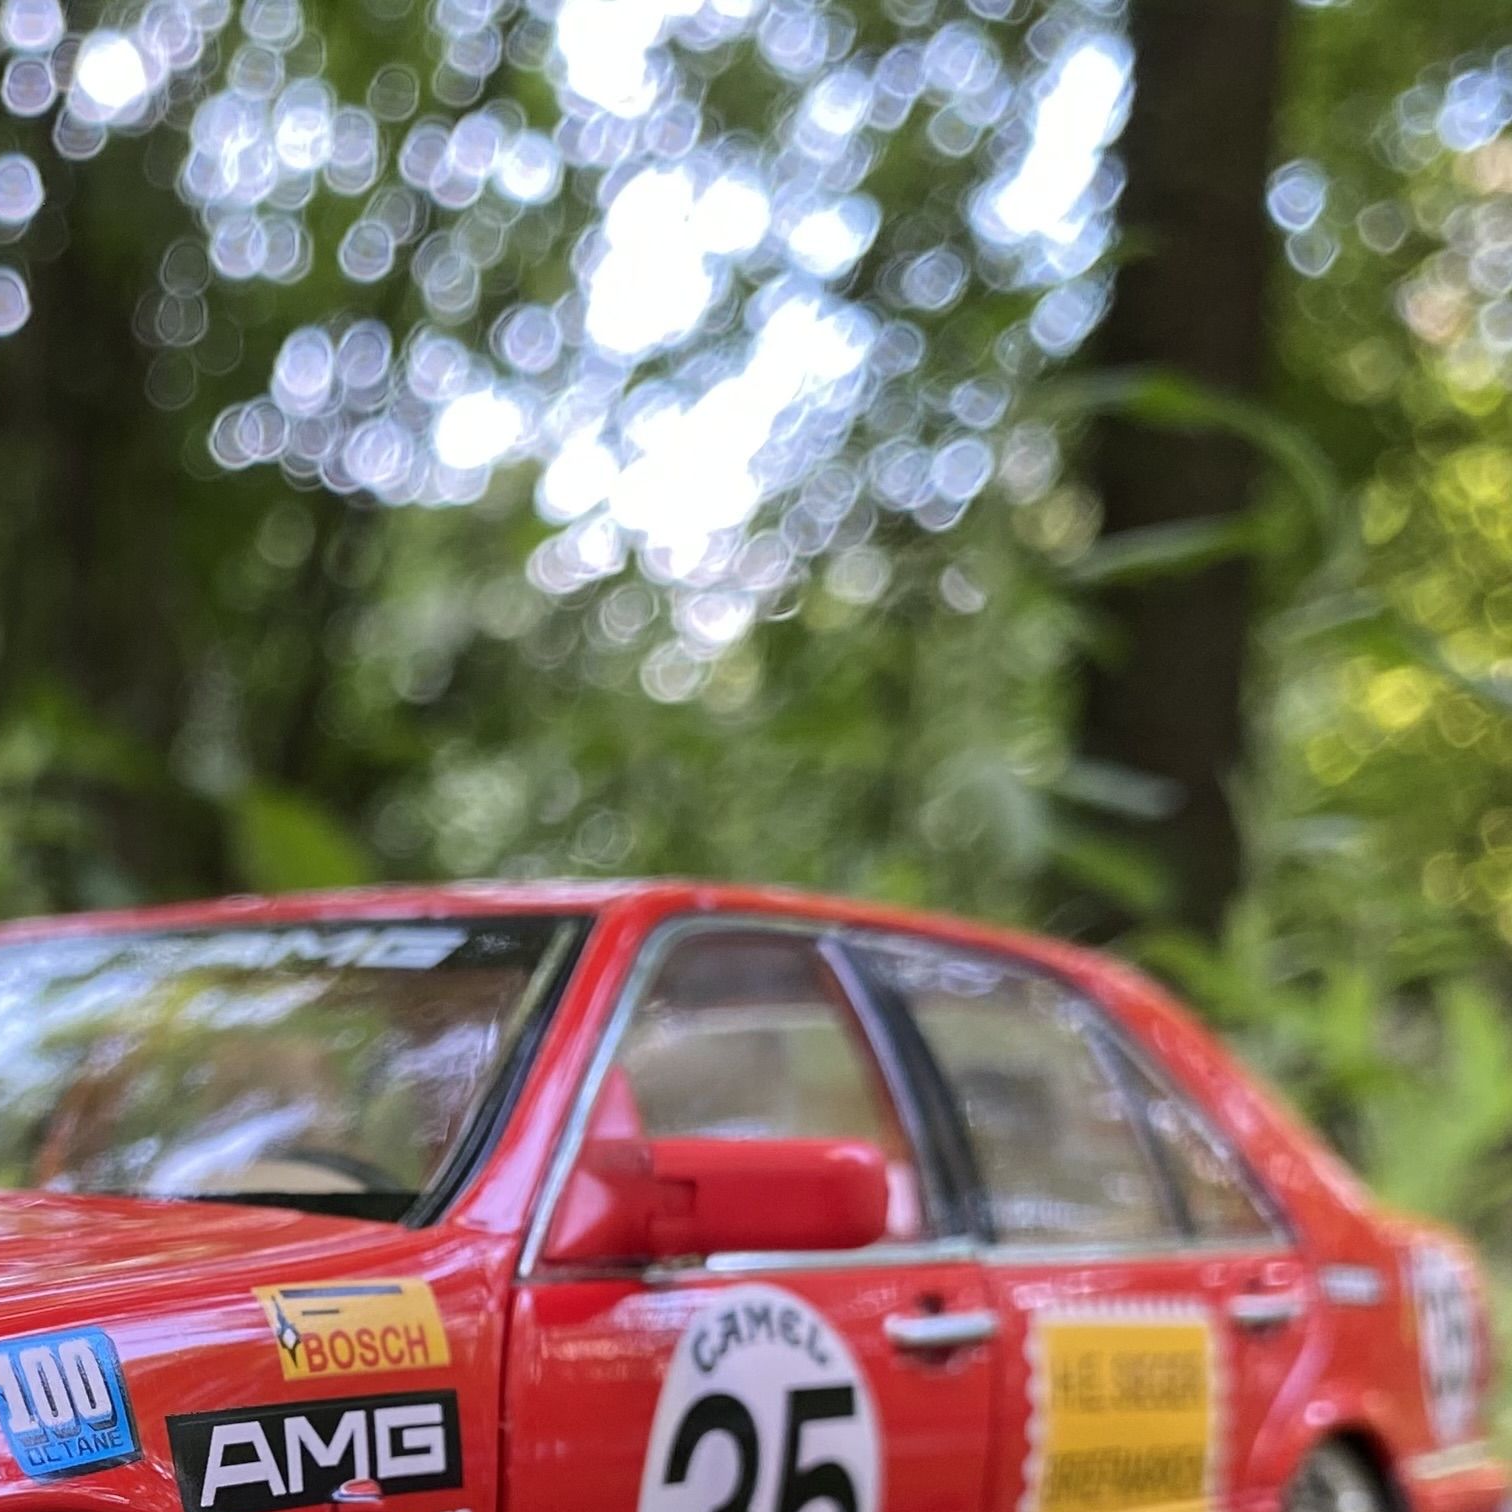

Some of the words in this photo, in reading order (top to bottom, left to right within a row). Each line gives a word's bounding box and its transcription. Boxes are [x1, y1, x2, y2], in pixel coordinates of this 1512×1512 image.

[301, 1323, 431, 1374] BOSCH
[691, 1305, 830, 1375] CAMEL
[25, 1428, 125, 1467] OCTANE
[200, 1403, 447, 1508] AMG
